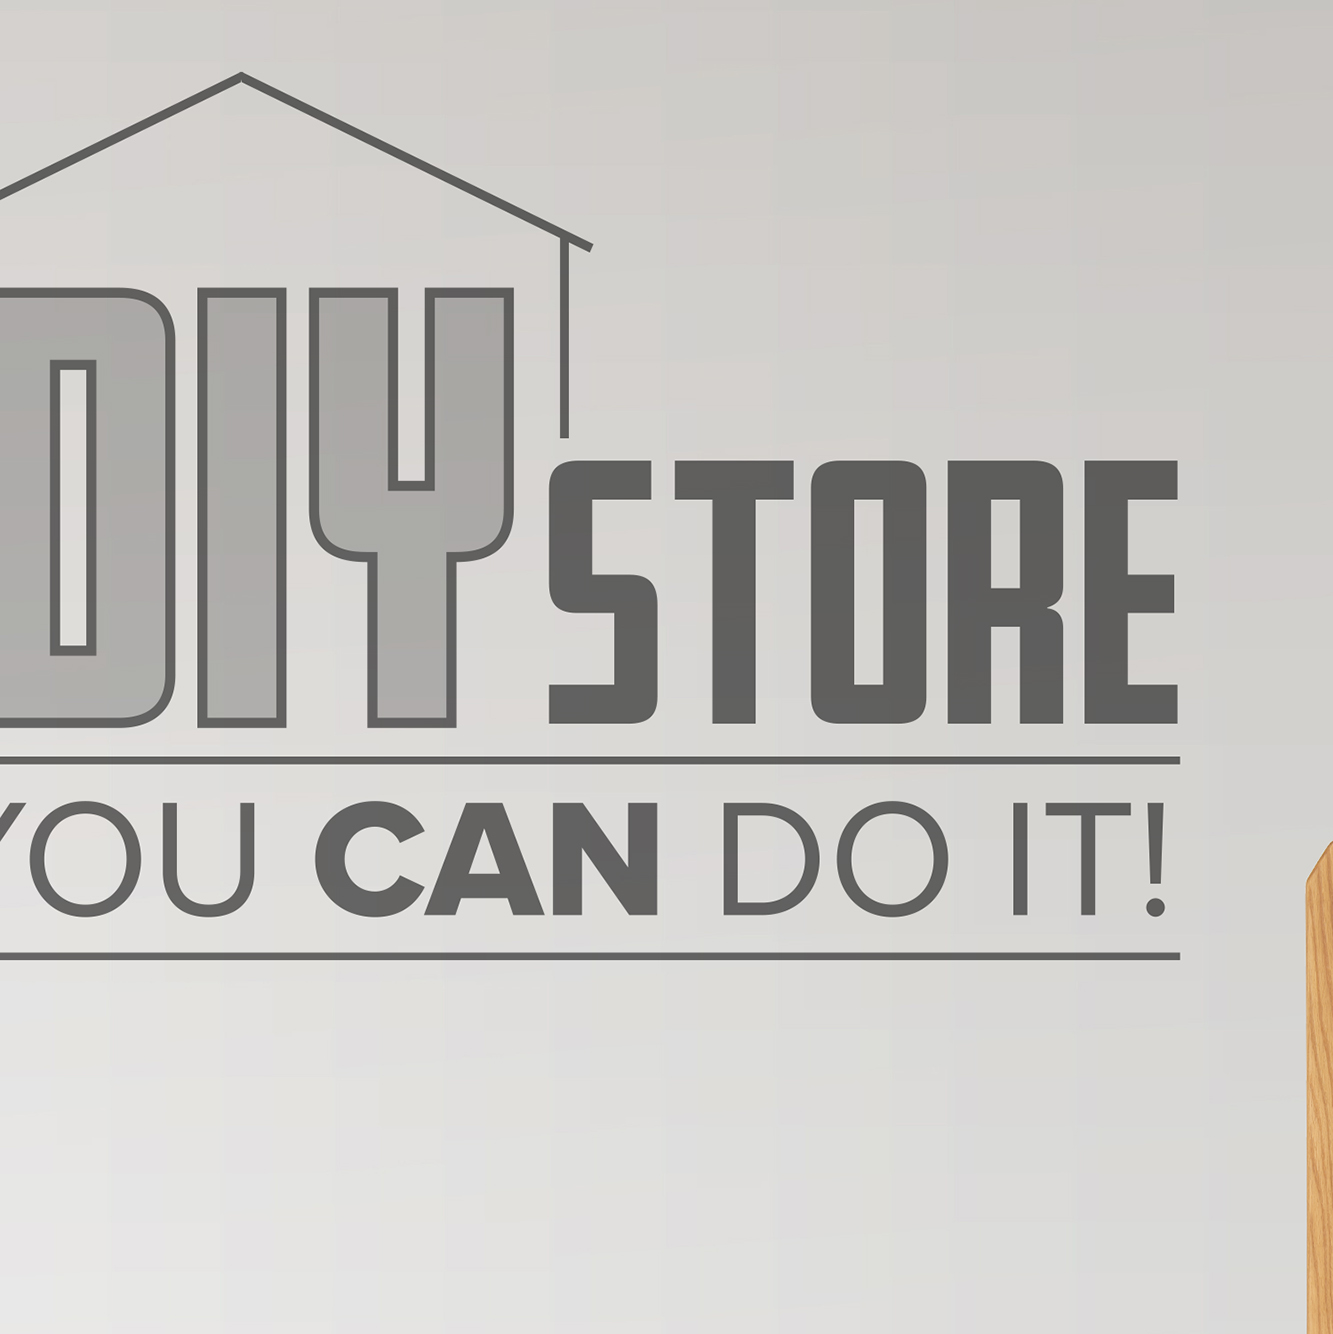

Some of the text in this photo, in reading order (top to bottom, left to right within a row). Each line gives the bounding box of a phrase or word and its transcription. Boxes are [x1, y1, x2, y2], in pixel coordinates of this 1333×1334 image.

[0, 287, 1178, 728] DIY STORE
[0, 801, 1165, 918] OU CAN DO IT!
